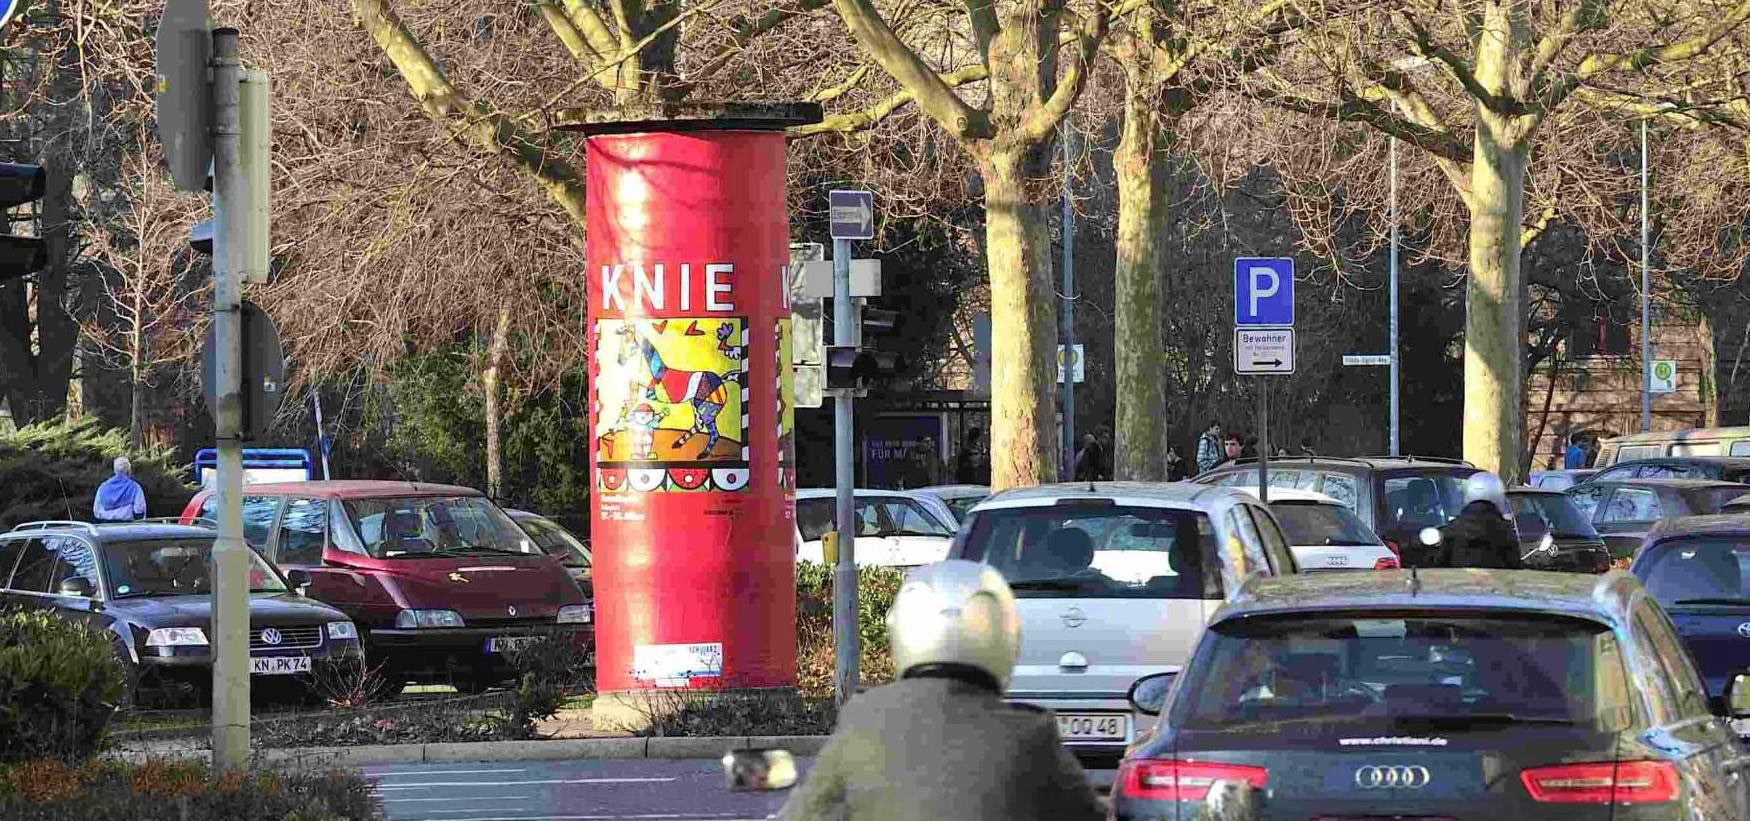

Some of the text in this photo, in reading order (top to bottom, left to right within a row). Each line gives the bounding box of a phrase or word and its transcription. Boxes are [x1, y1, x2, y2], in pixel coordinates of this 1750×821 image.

[601, 263, 734, 311] KNIE
[1249, 266, 1280, 316] P
[1243, 333, 1286, 343] Bewohner
[872, 446, 890, 459] FÜR
[254, 659, 307, 671] KN PK 74
[1097, 718, 1117, 734] 48
[1339, 737, 1447, 746] www.christiani.de
